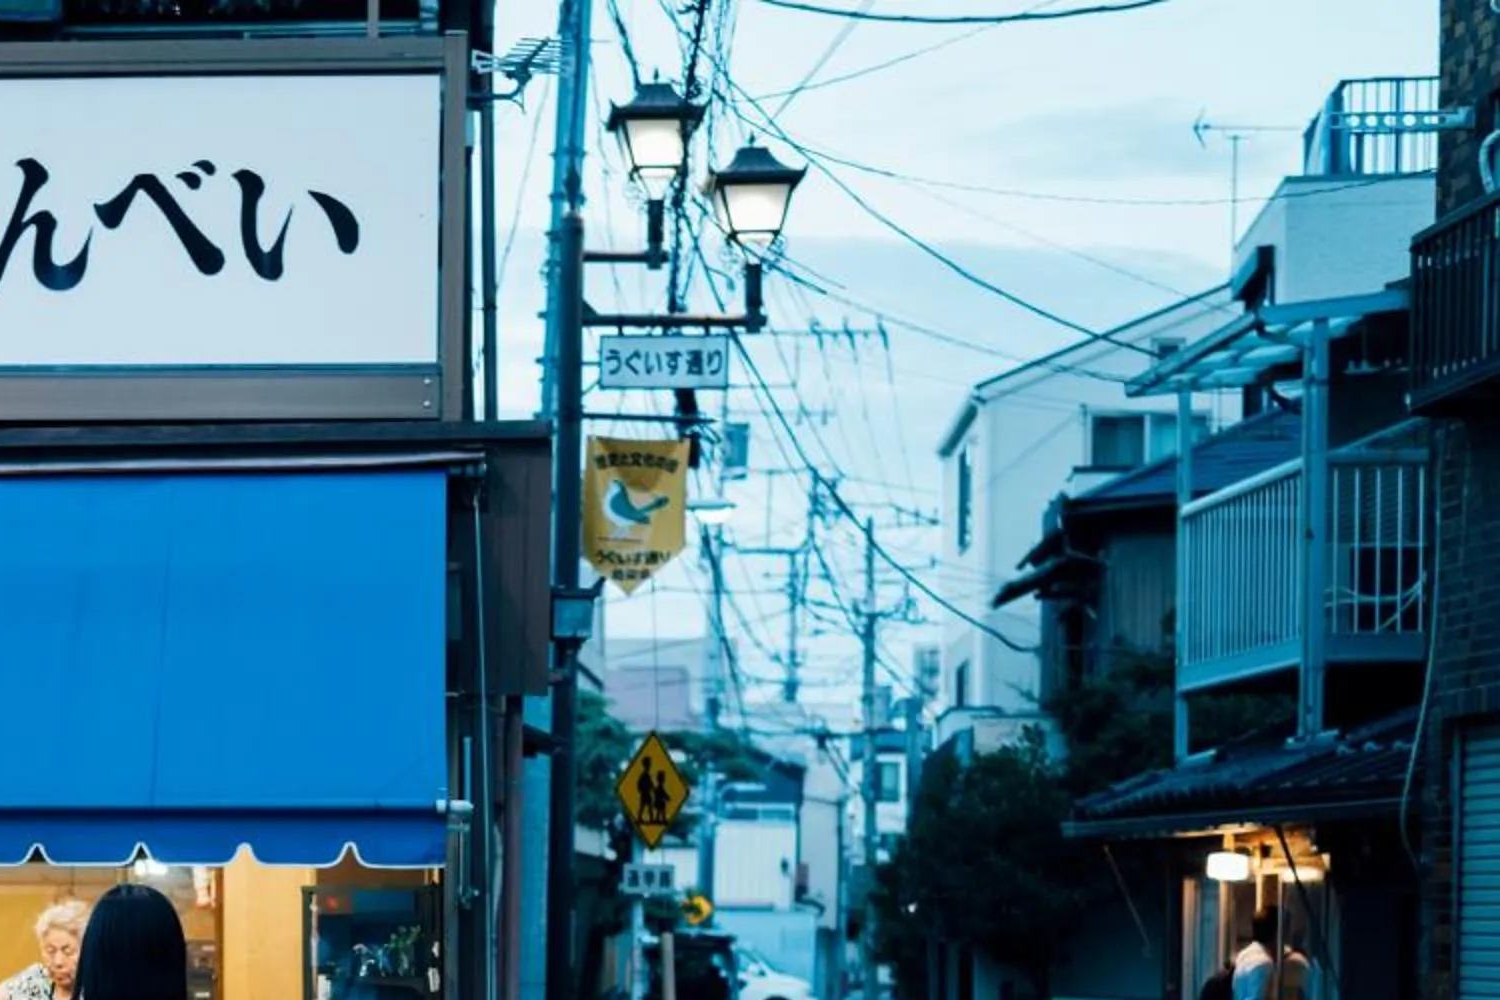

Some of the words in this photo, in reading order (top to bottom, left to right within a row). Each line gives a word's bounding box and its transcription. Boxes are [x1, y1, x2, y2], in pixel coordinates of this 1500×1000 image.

[605, 349, 723, 376] うぐいす通り
